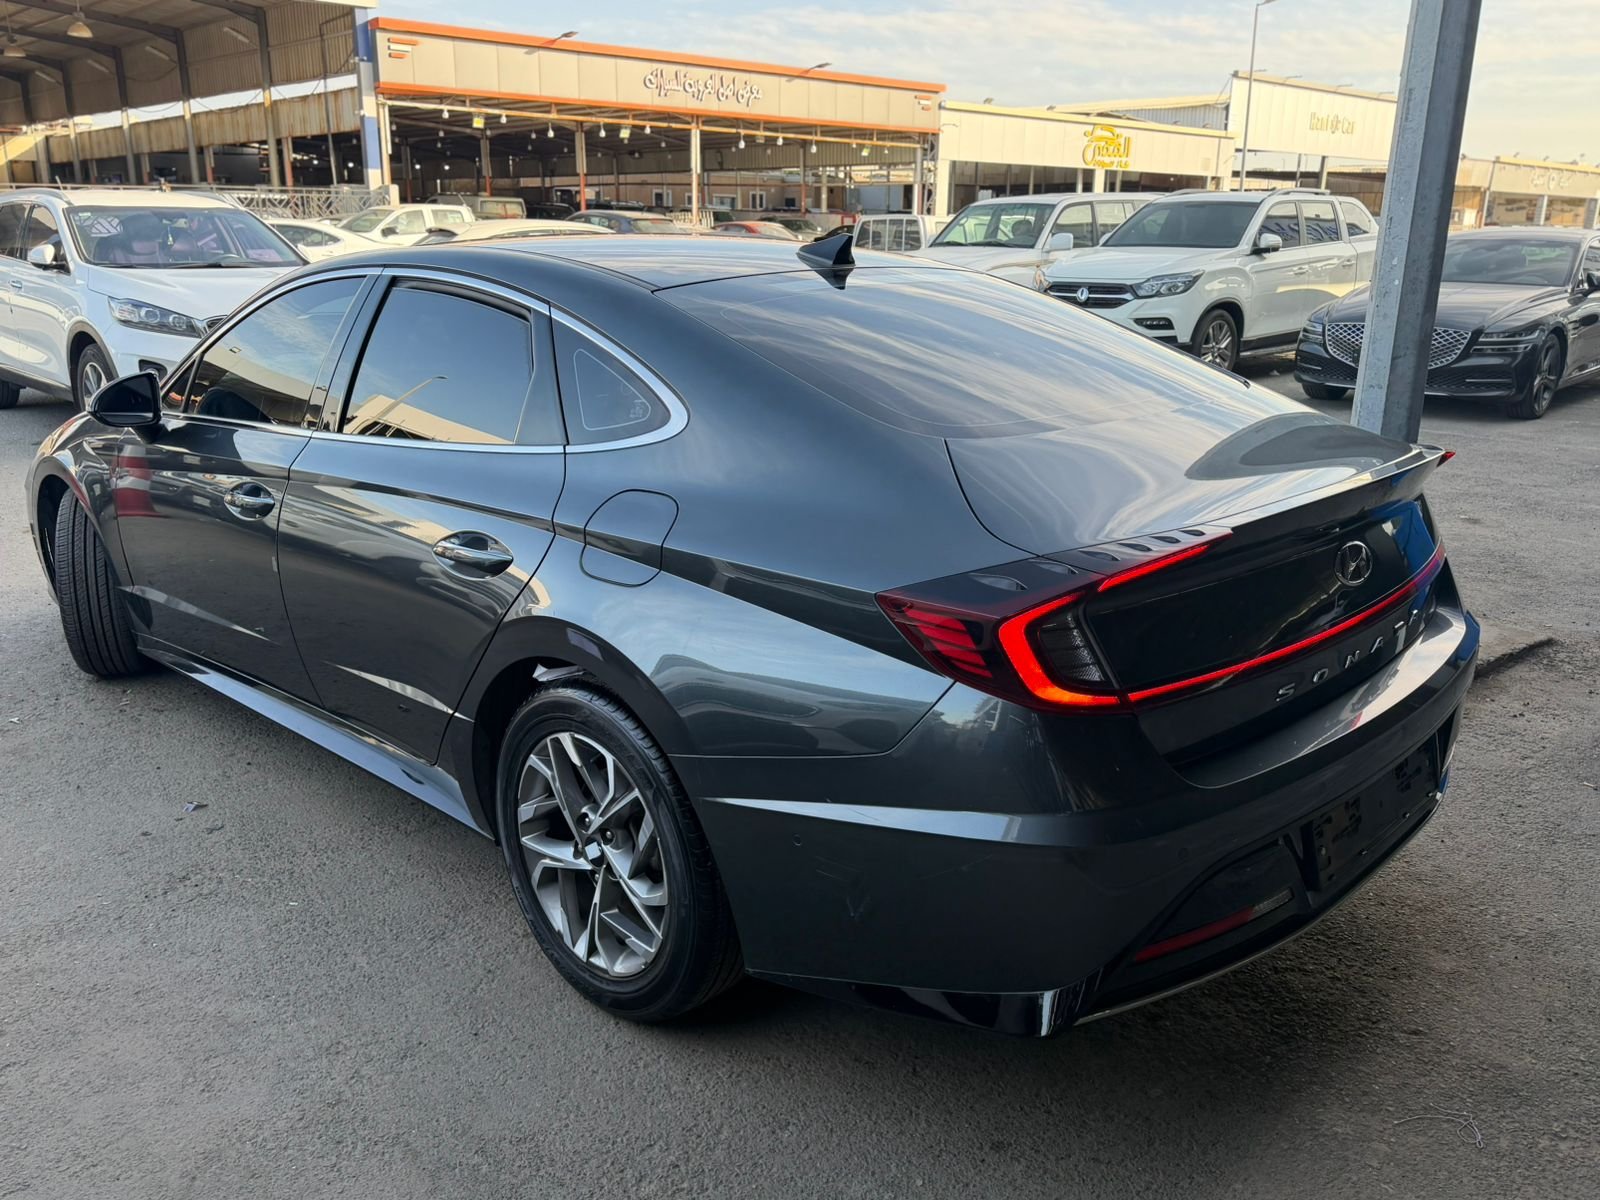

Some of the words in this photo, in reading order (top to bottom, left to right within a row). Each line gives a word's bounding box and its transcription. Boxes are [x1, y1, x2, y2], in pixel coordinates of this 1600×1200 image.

[643, 67, 683, 97] للسيارات
[736, 79, 763, 107] معرض
[1276, 609, 1419, 702] SONATA
